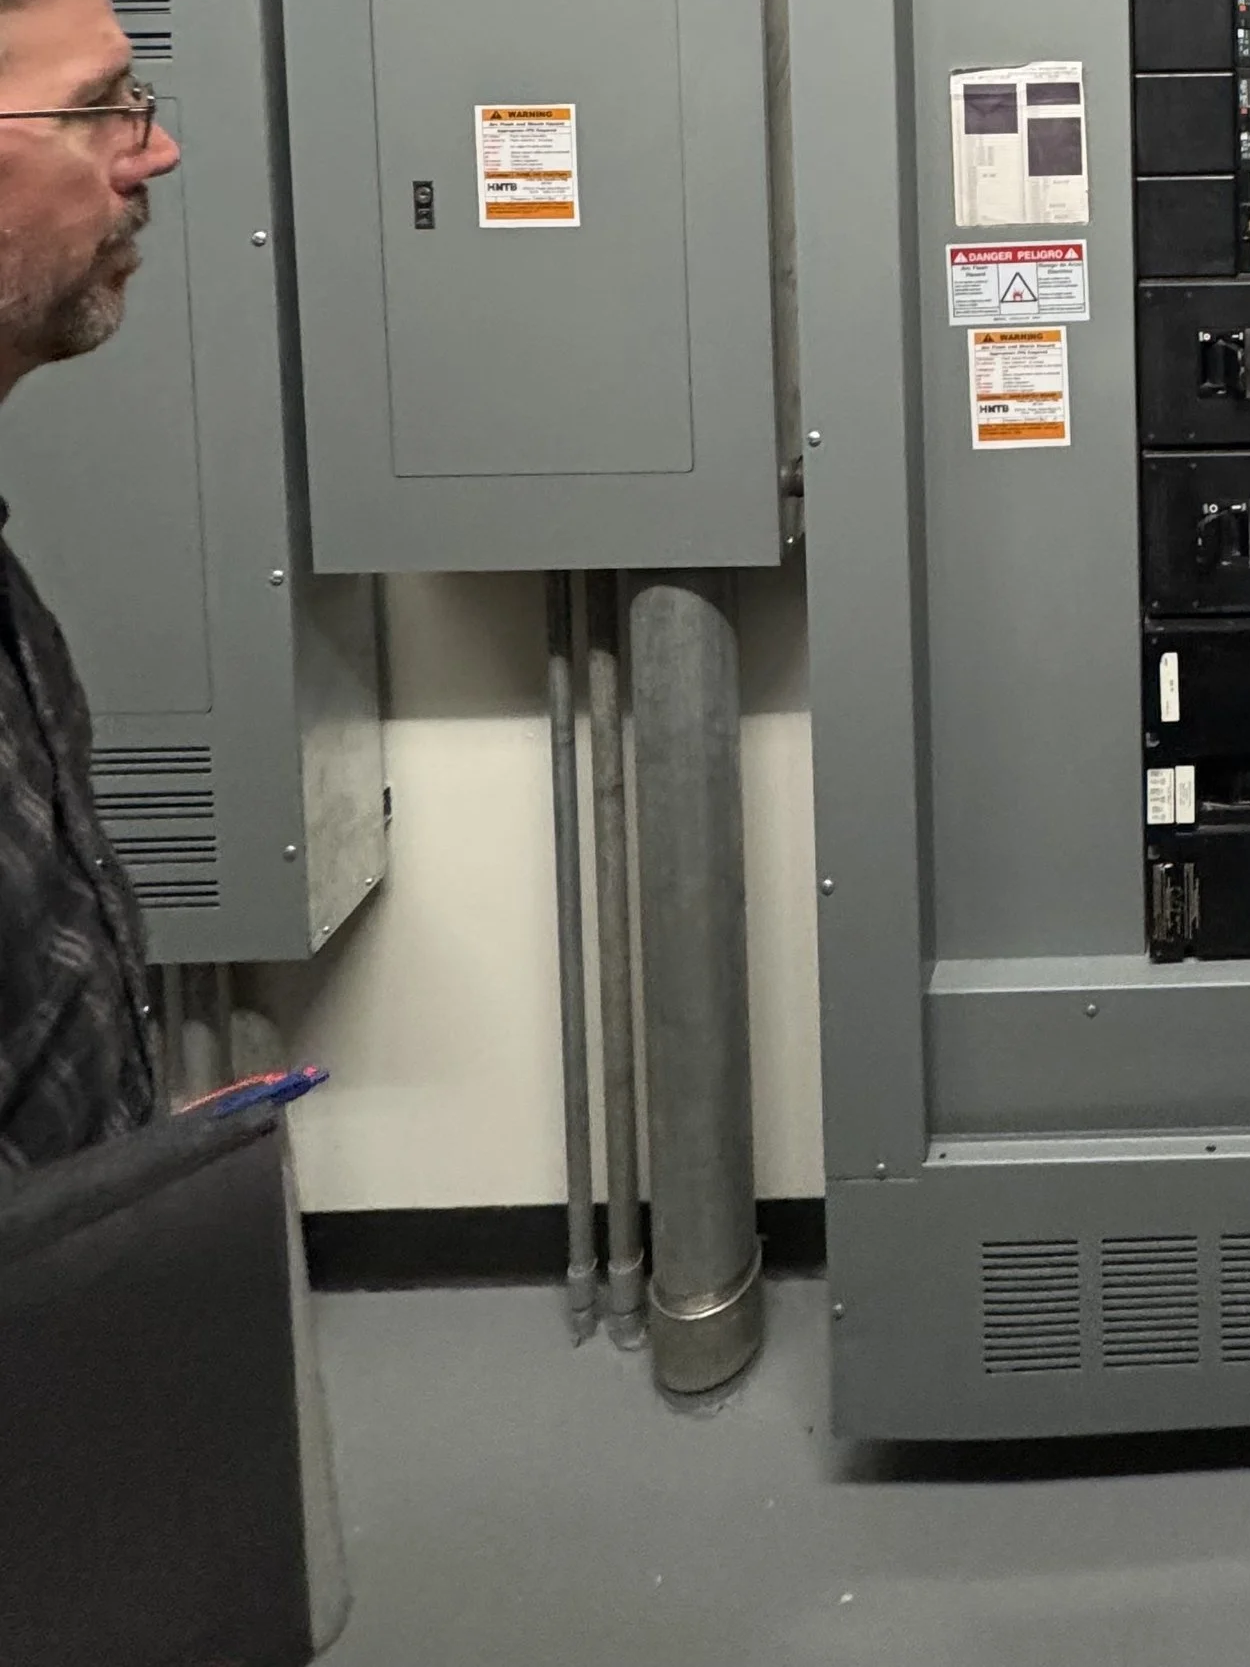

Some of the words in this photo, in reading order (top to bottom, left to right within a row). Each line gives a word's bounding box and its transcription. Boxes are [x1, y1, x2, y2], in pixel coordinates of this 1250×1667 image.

[507, 110, 553, 119] WARNING
[969, 251, 1013, 263] DANGER
[1017, 249, 1064, 260] PELIGRO
[999, 332, 1044, 342] WARNING
